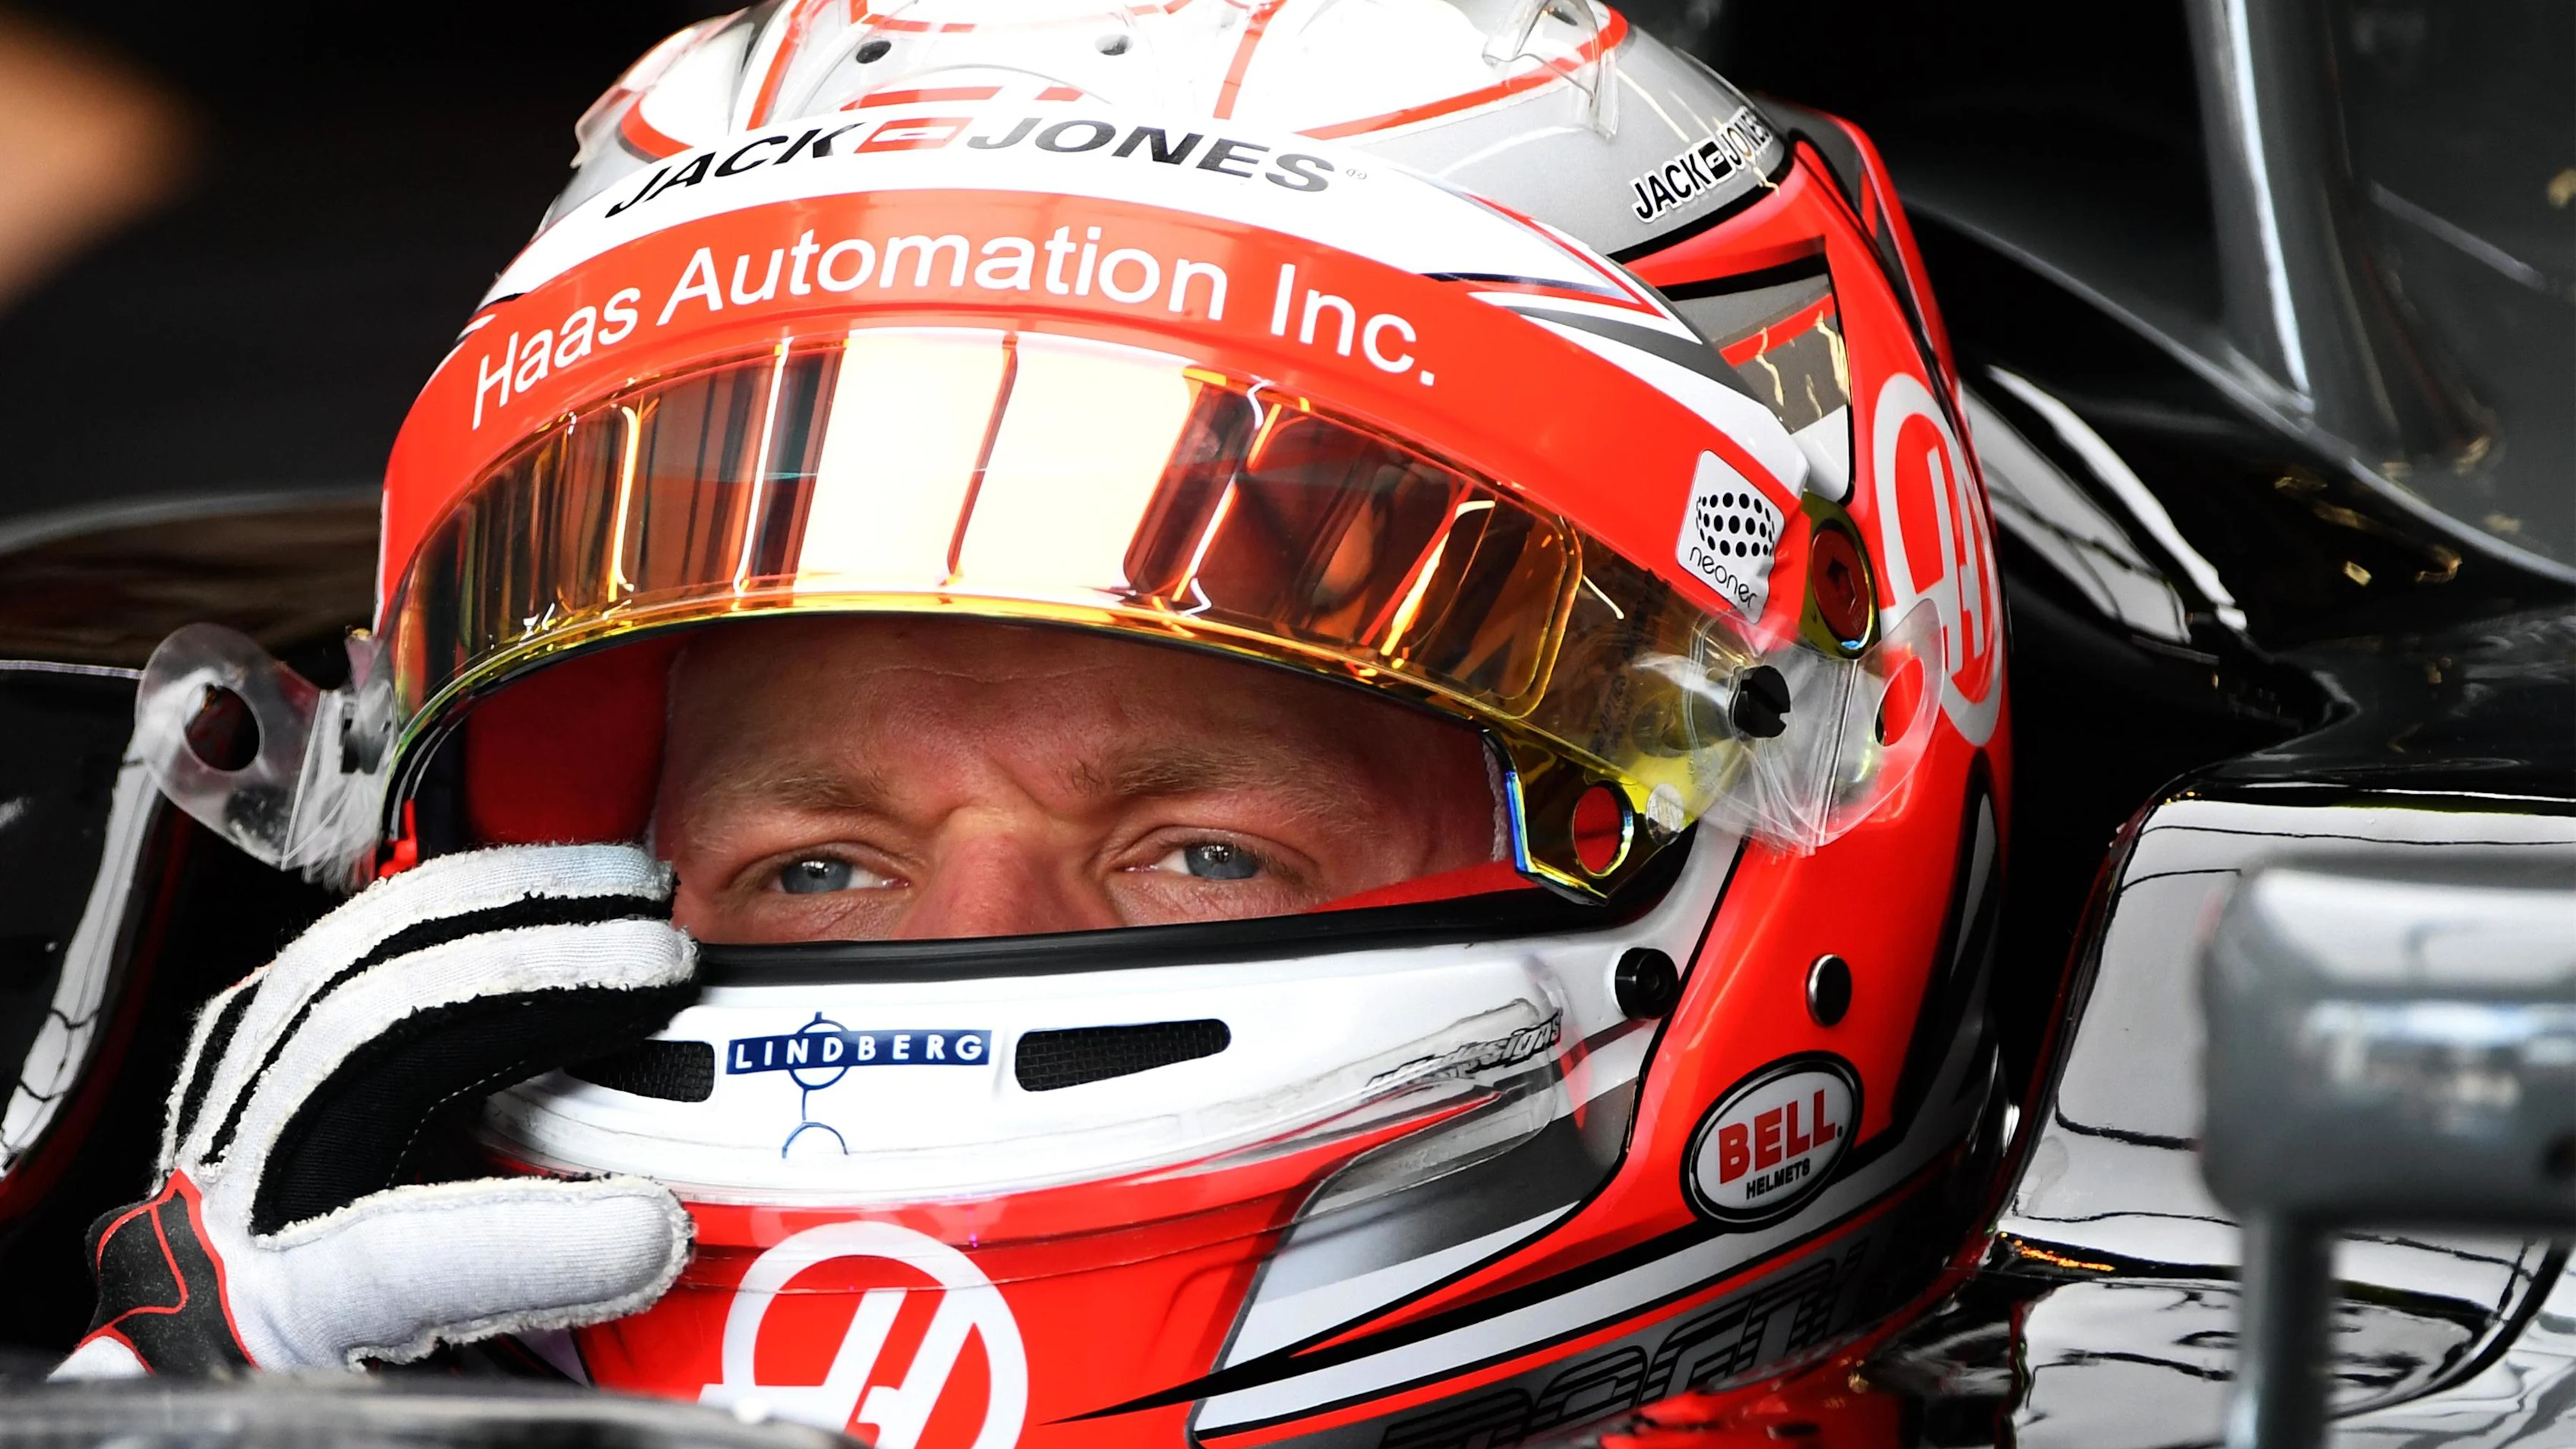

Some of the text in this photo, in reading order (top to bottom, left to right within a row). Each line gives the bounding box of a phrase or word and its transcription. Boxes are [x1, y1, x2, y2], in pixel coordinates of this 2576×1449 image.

[605, 117, 1334, 218] JACK JONES
[1634, 110, 1769, 219] JACK JONES
[472, 226, 1435, 430] Haas Automation Inc.
[735, 1034, 983, 1069] LINDBERG
[1719, 1089, 1836, 1185] BELL
[1746, 1158, 1810, 1200] HELMETS
